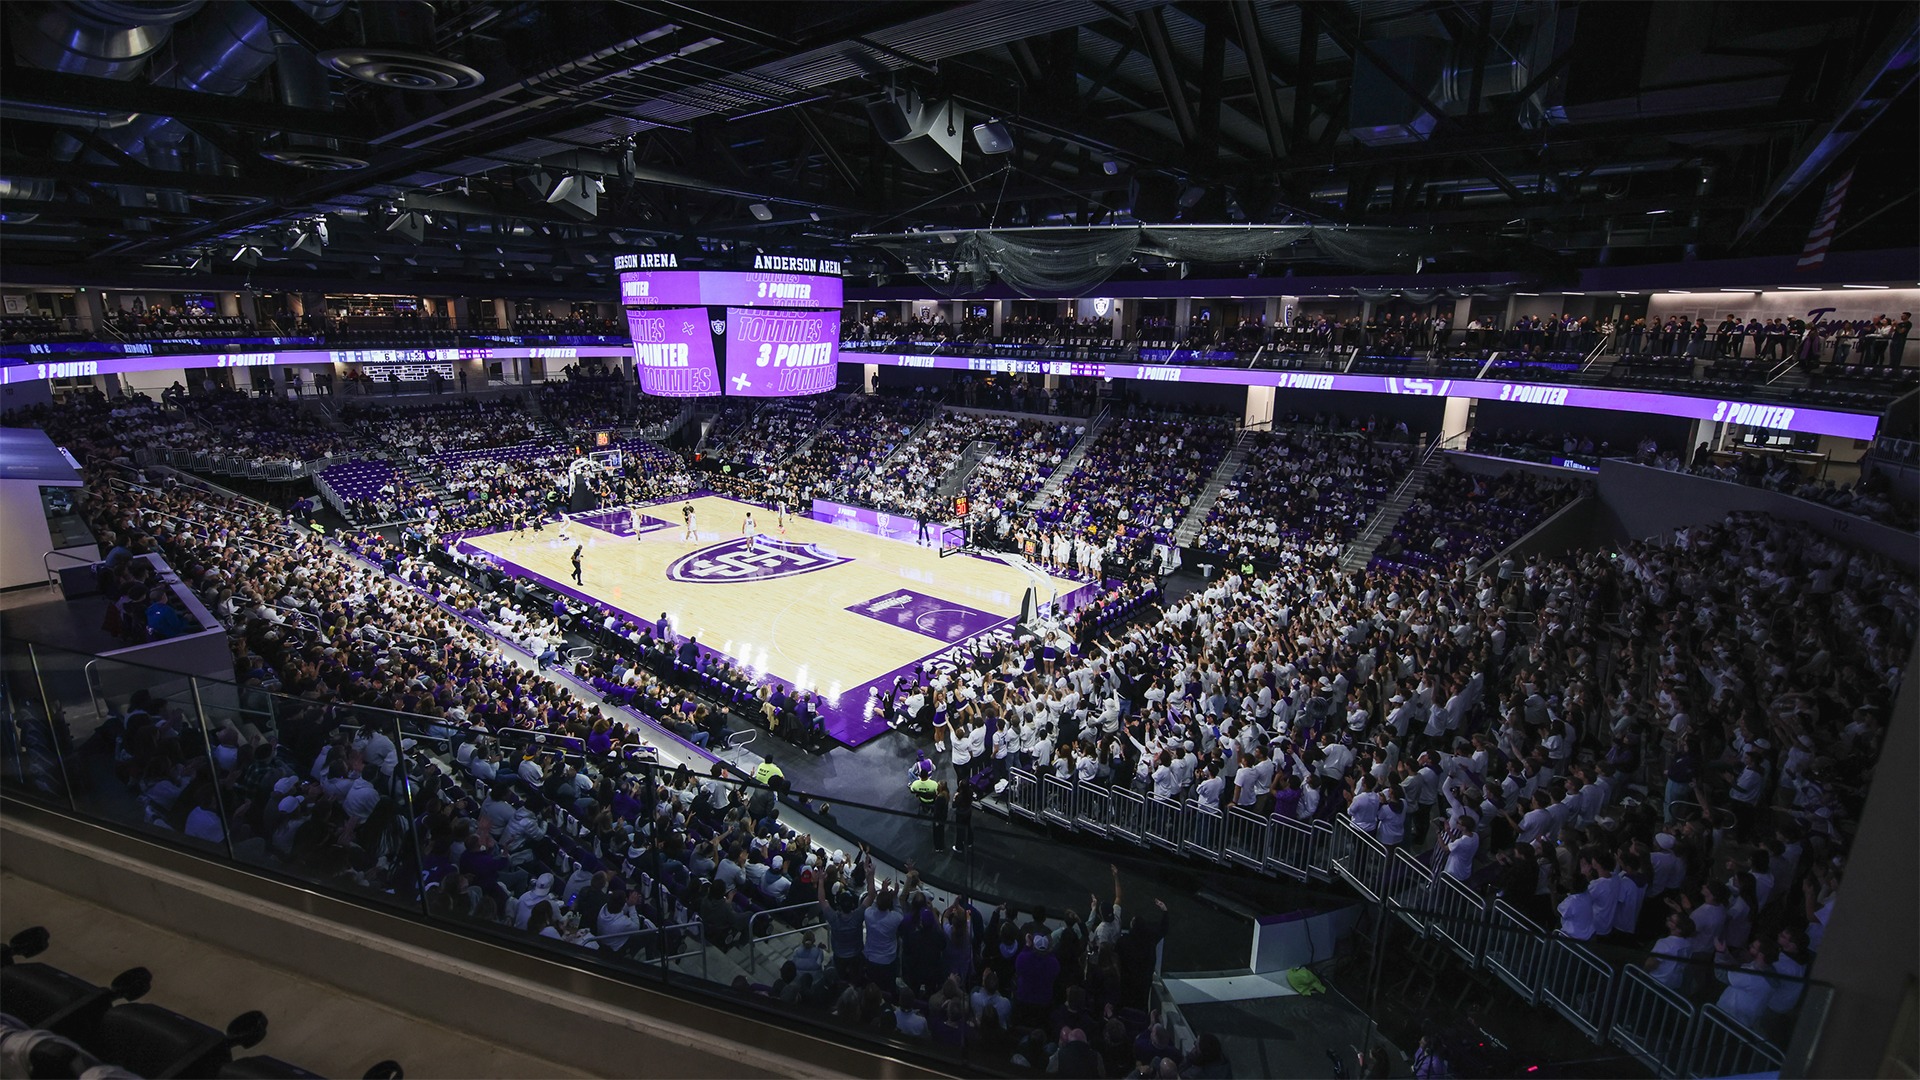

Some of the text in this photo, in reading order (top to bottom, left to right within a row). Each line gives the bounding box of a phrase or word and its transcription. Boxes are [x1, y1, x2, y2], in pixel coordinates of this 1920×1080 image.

[640, 253, 678, 268] ARENA
[754, 255, 842, 275] ANDERSON ARENA
[758, 282, 812, 299] 3 POINTER
[738, 316, 823, 343] TOMMIES
[217, 353, 276, 367] 3 POINTER
[384, 352, 391, 361] 6
[529, 348, 577, 359] 3 POINTER
[756, 342, 832, 367] 3 POINTER
[898, 356, 935, 368] 3 POINTER
[38, 361, 98, 379] 3 POINTER
[1006, 362, 1012, 371] 6
[1055, 365, 1061, 374] 8
[1136, 367, 1181, 382] 3 POINTER
[644, 366, 712, 392] TOMMIES
[779, 364, 838, 392] TOMMIES
[1278, 373, 1335, 390] 3 POINTER
[1499, 384, 1569, 406] 3 POINTER
[1713, 402, 1795, 430] 3 POINTER
[956, 503, 967, 515] 30
